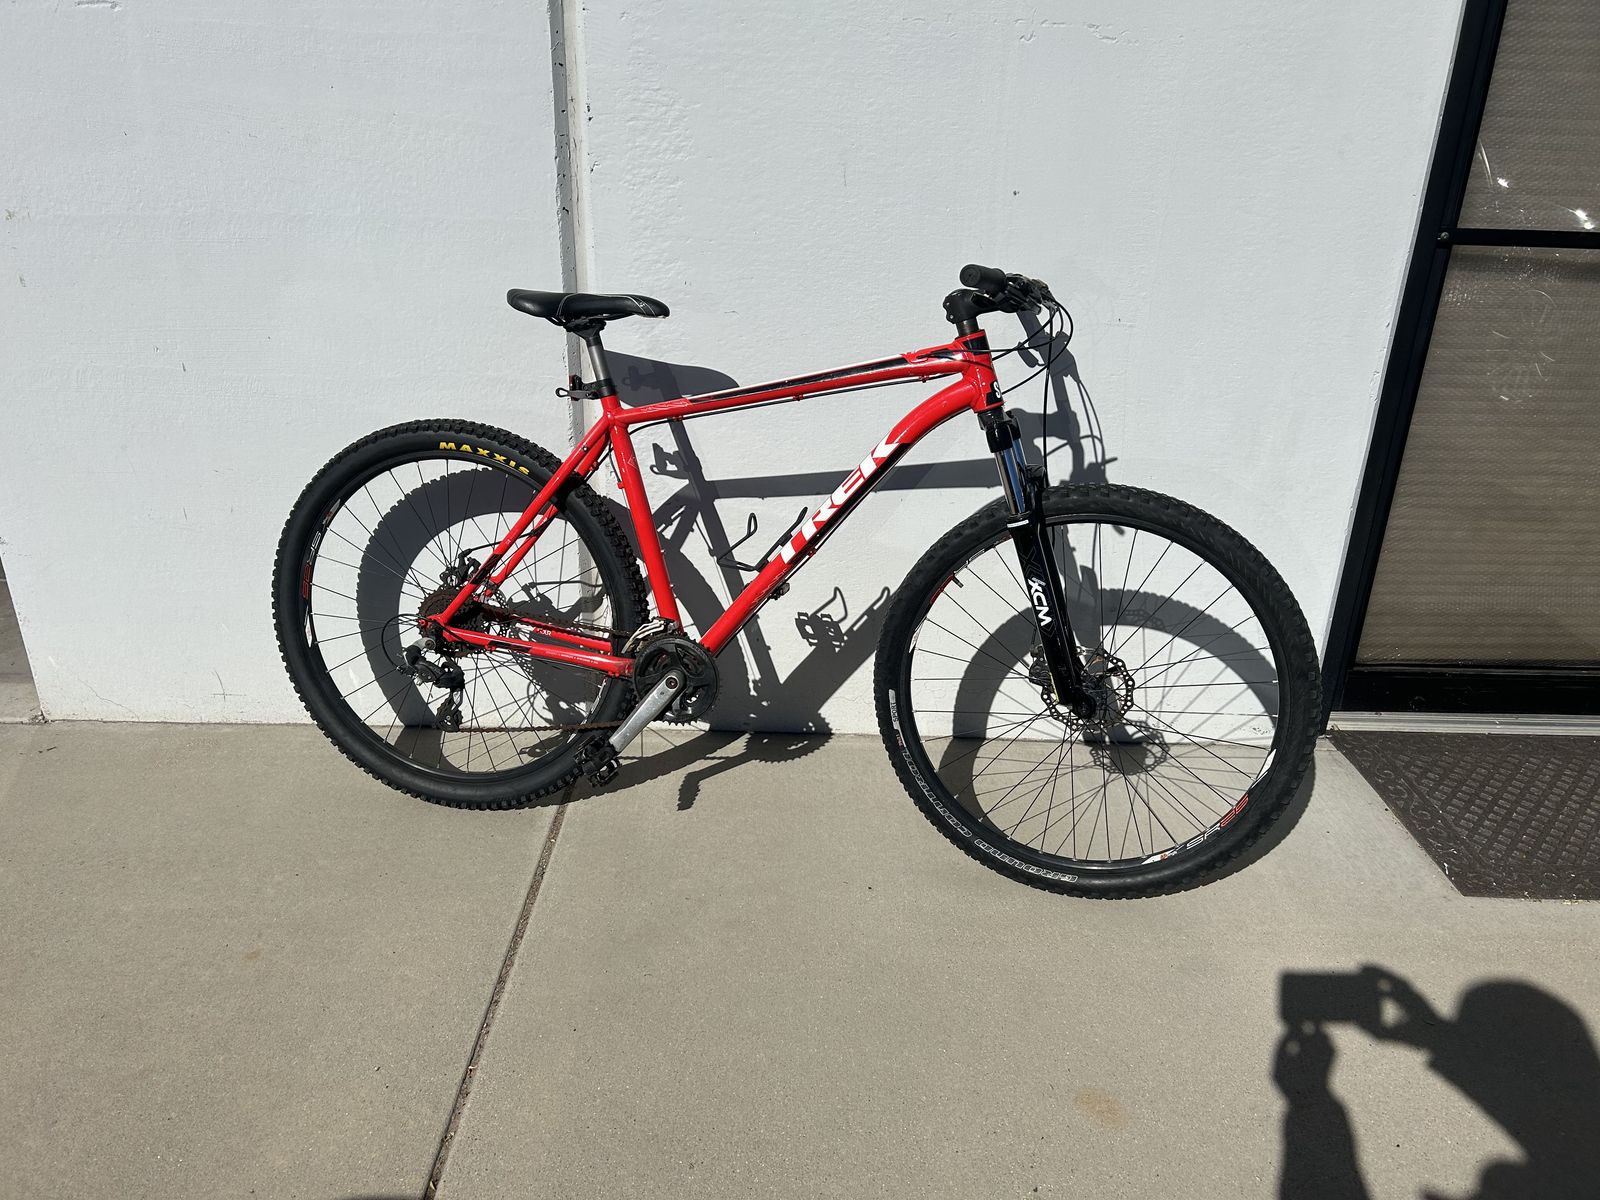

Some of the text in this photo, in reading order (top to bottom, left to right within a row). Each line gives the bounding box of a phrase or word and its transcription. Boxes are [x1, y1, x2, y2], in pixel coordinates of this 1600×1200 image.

[439, 441, 530, 475] MAXXIS
[767, 428, 900, 565] TREK
[1027, 578, 1052, 627] XCM
[891, 701, 899, 723] SPORT
[901, 748, 1079, 883] GROUND CONTROL
